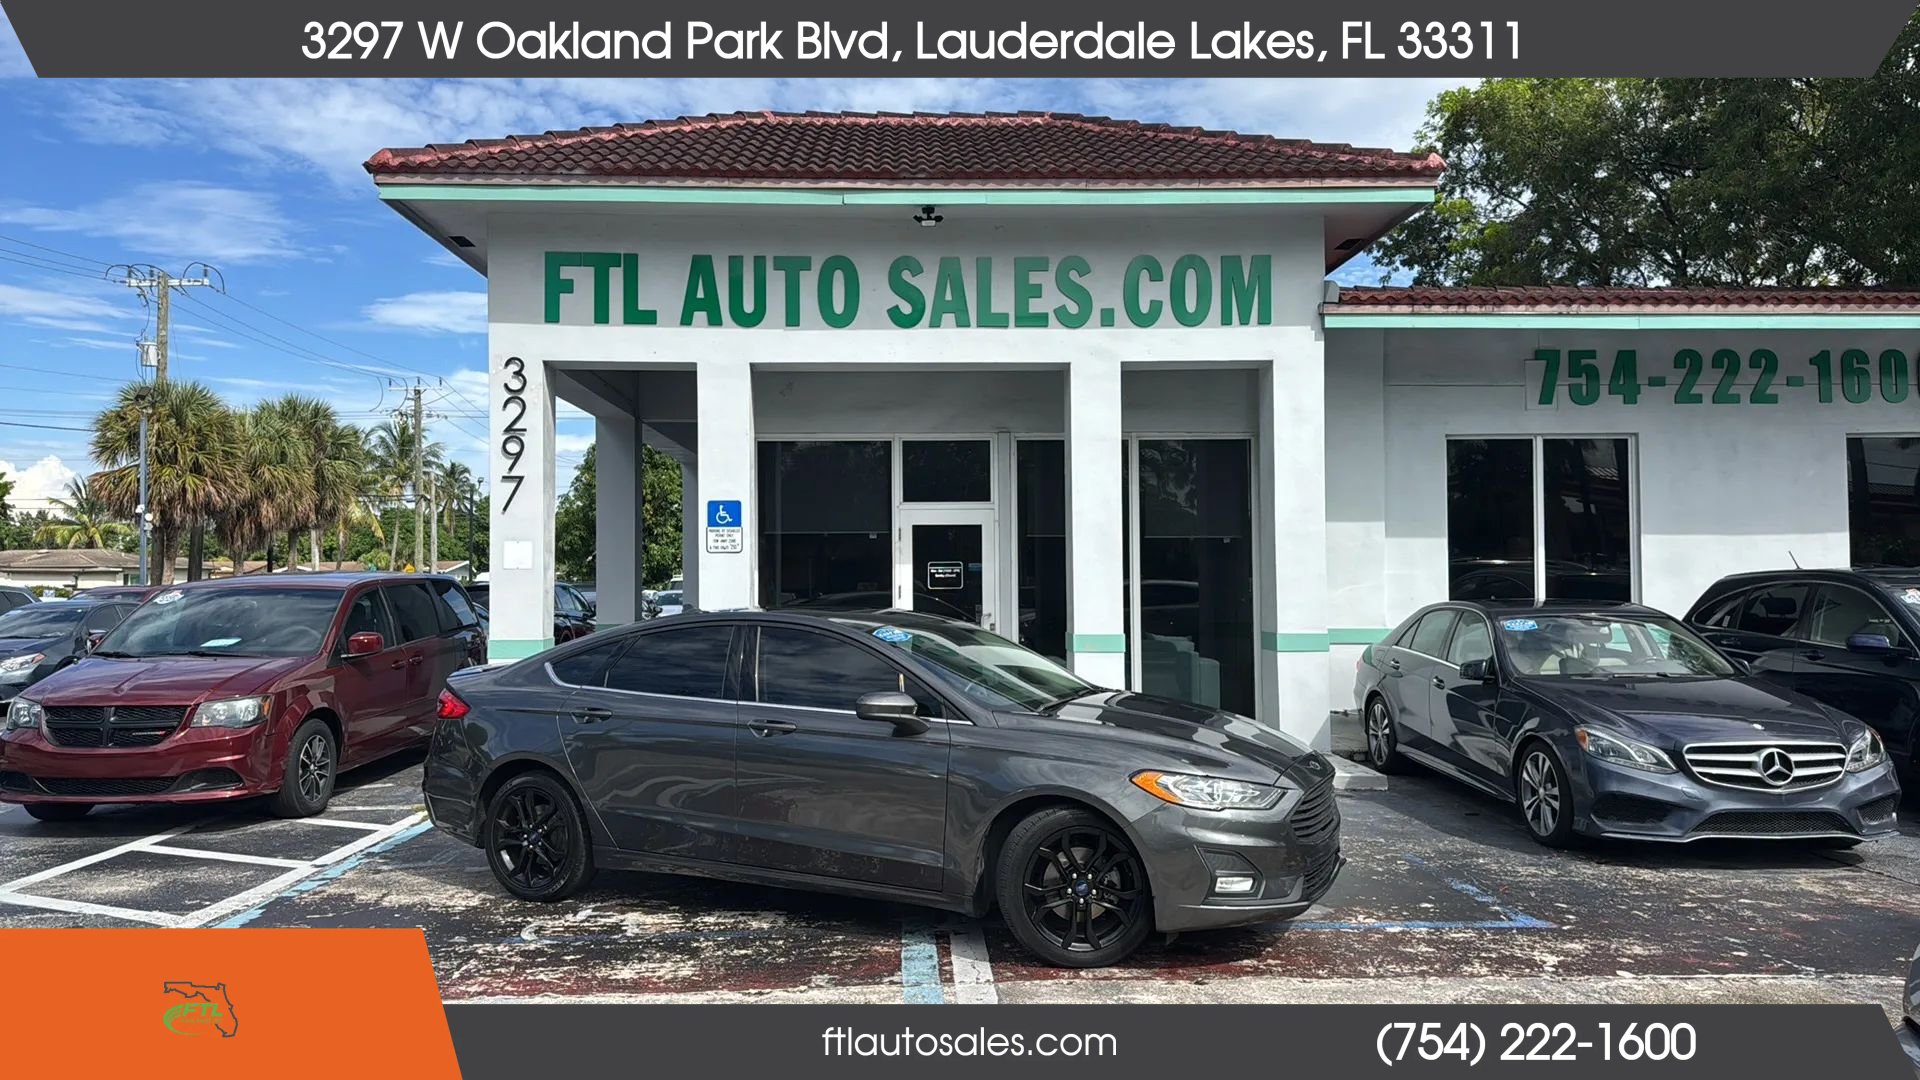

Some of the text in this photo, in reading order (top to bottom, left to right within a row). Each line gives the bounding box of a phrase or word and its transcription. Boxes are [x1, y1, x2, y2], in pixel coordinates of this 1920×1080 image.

[544, 251, 1272, 329] FTL AUTO SALES.COM
[1534, 348, 1920, 405] 754-222-160
[502, 356, 527, 513] 3297
